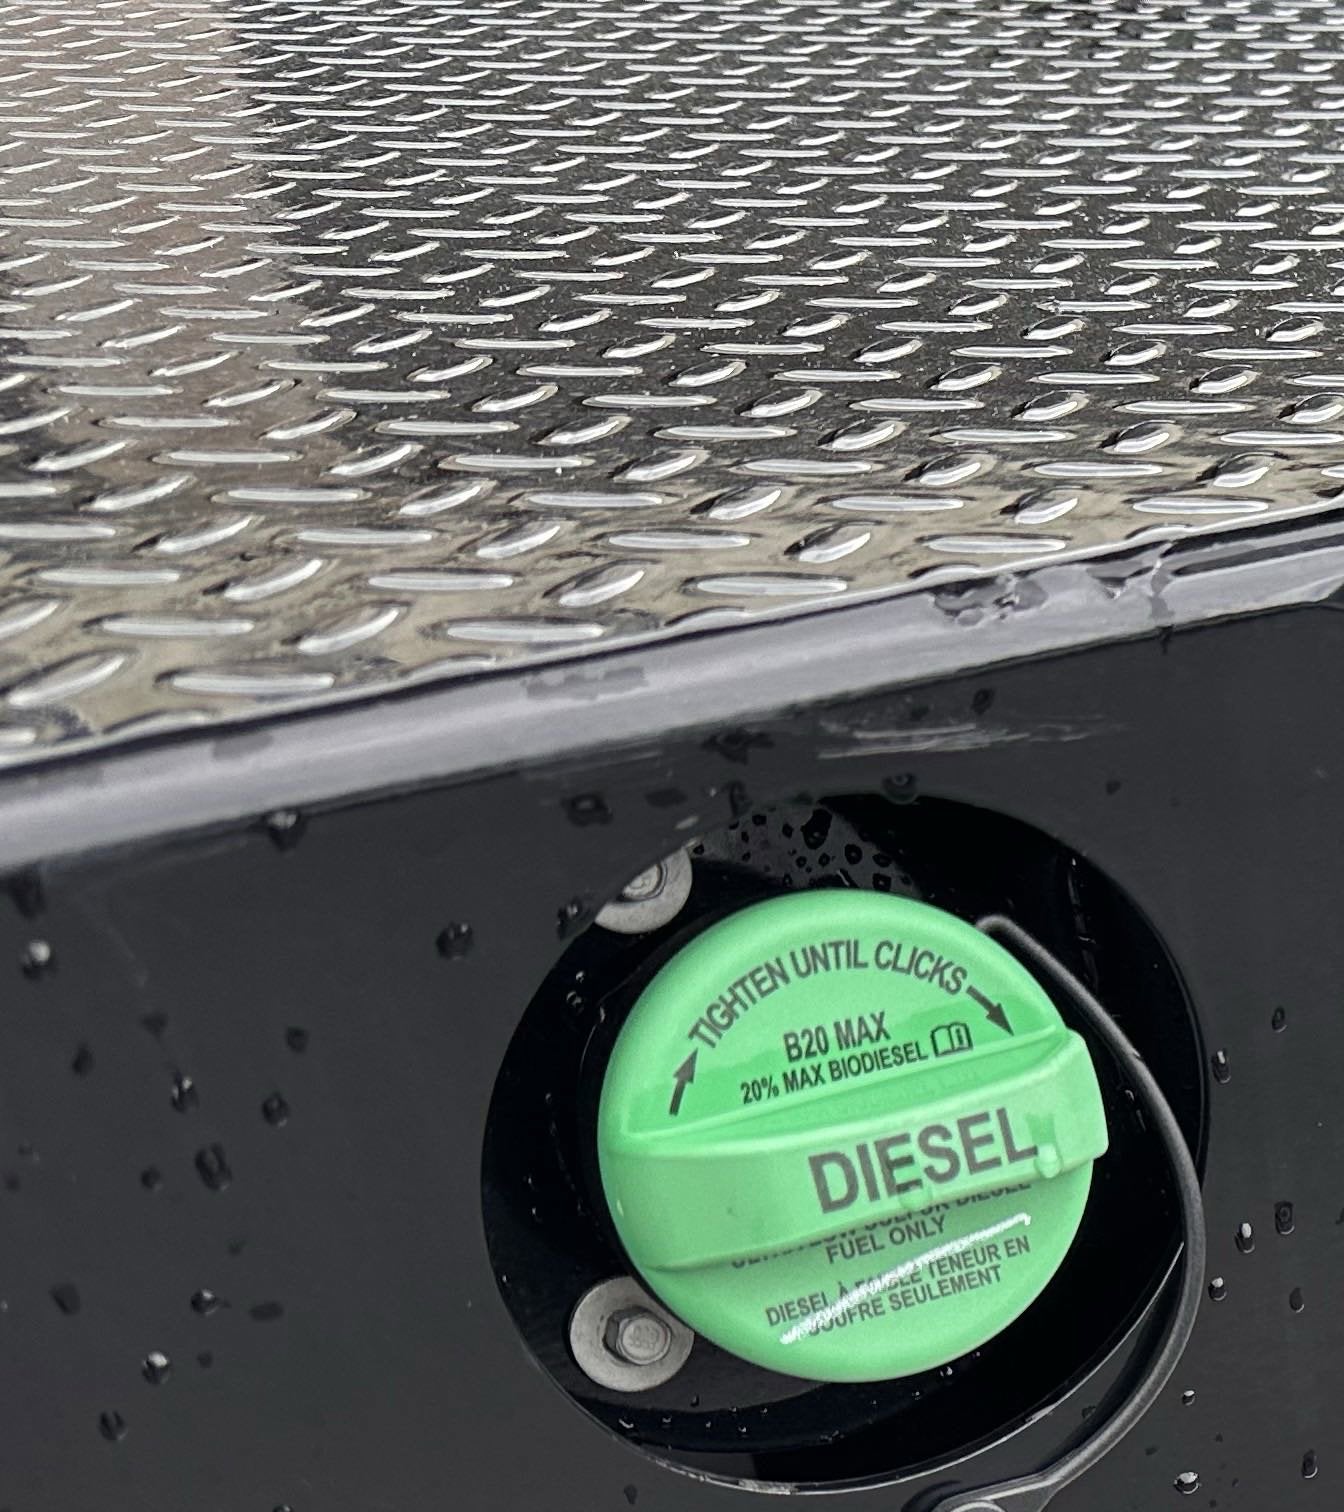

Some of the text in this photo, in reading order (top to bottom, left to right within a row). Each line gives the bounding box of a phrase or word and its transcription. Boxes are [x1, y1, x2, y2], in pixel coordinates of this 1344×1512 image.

[687, 939, 968, 1049] TIGHTEN UNTIL CLICKS
[783, 1010, 892, 1064] B20 MAX
[740, 1041, 929, 1105] 20% MAX BIODIESEL
[807, 1106, 1039, 1215] DIESEL
[825, 1234, 885, 1265] FUEL
[888, 1214, 946, 1247] ONLY
[1003, 1235, 1031, 1258] EN
[888, 1264, 1001, 1312] SEULEMENT
